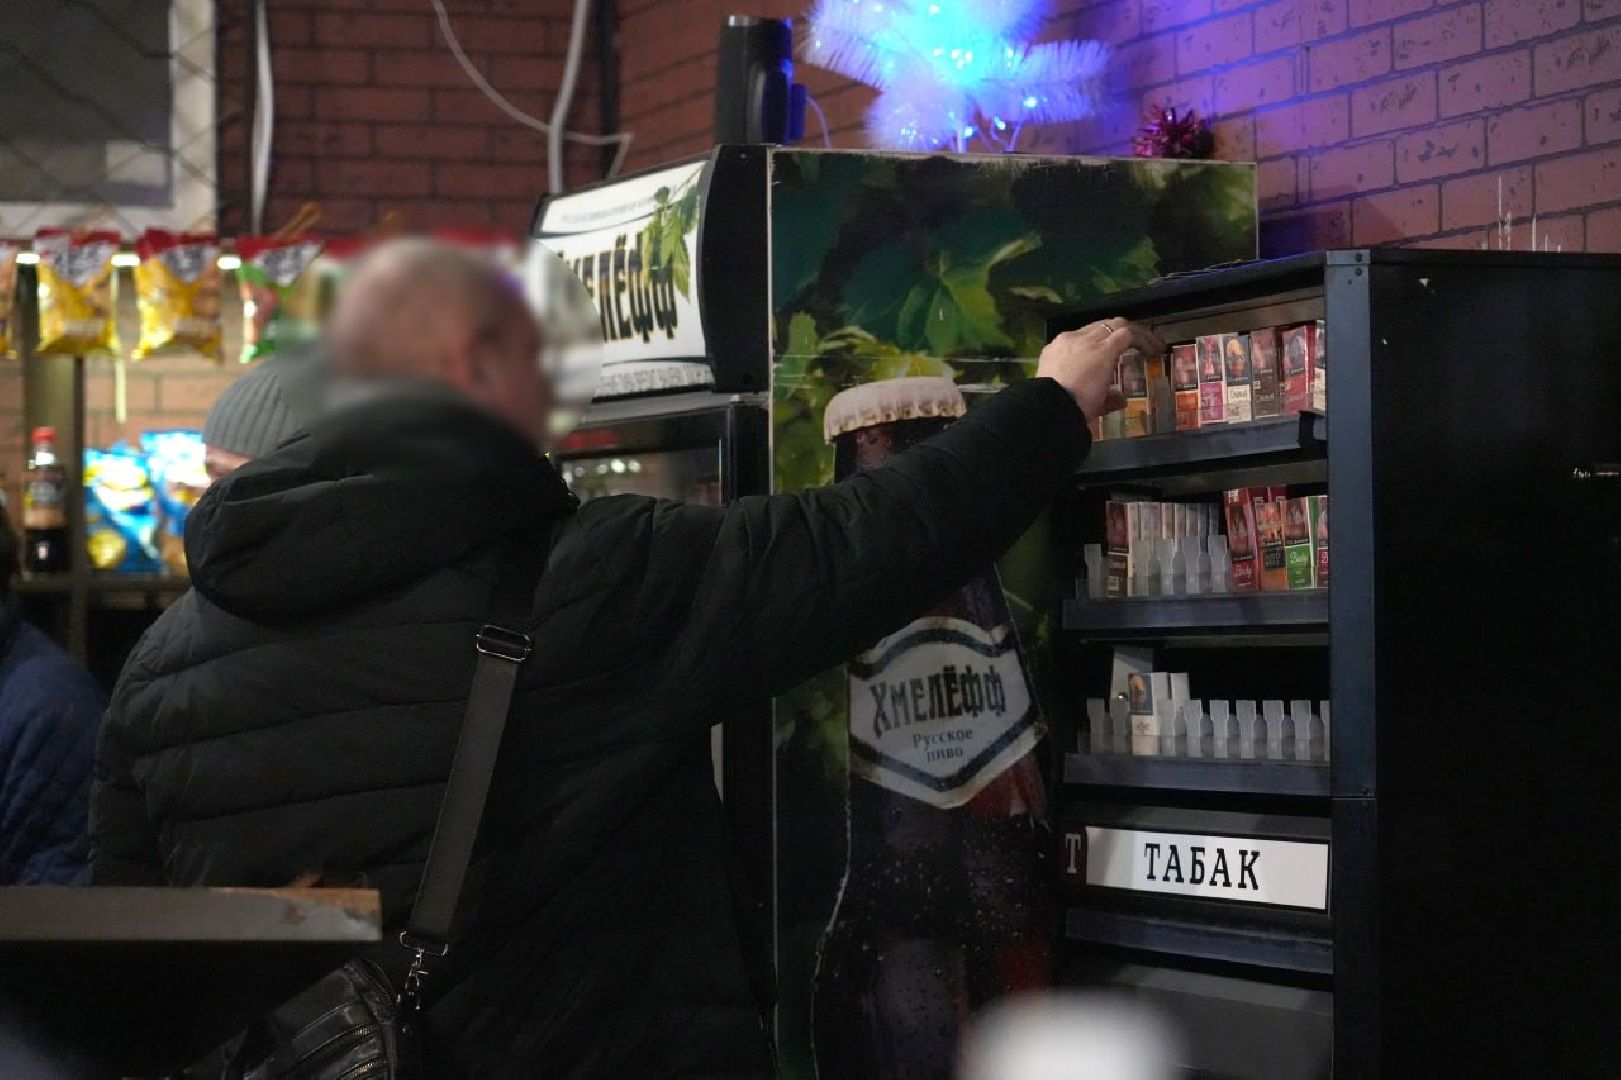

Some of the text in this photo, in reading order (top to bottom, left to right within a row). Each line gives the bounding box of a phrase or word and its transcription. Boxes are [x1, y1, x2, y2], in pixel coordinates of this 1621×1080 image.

[870, 664, 1006, 739] ХМЕЛЁФФ
[913, 728, 973, 749] Русское
[927, 749, 963, 763] пиво
[1144, 843, 1260, 890] ТАБАК
